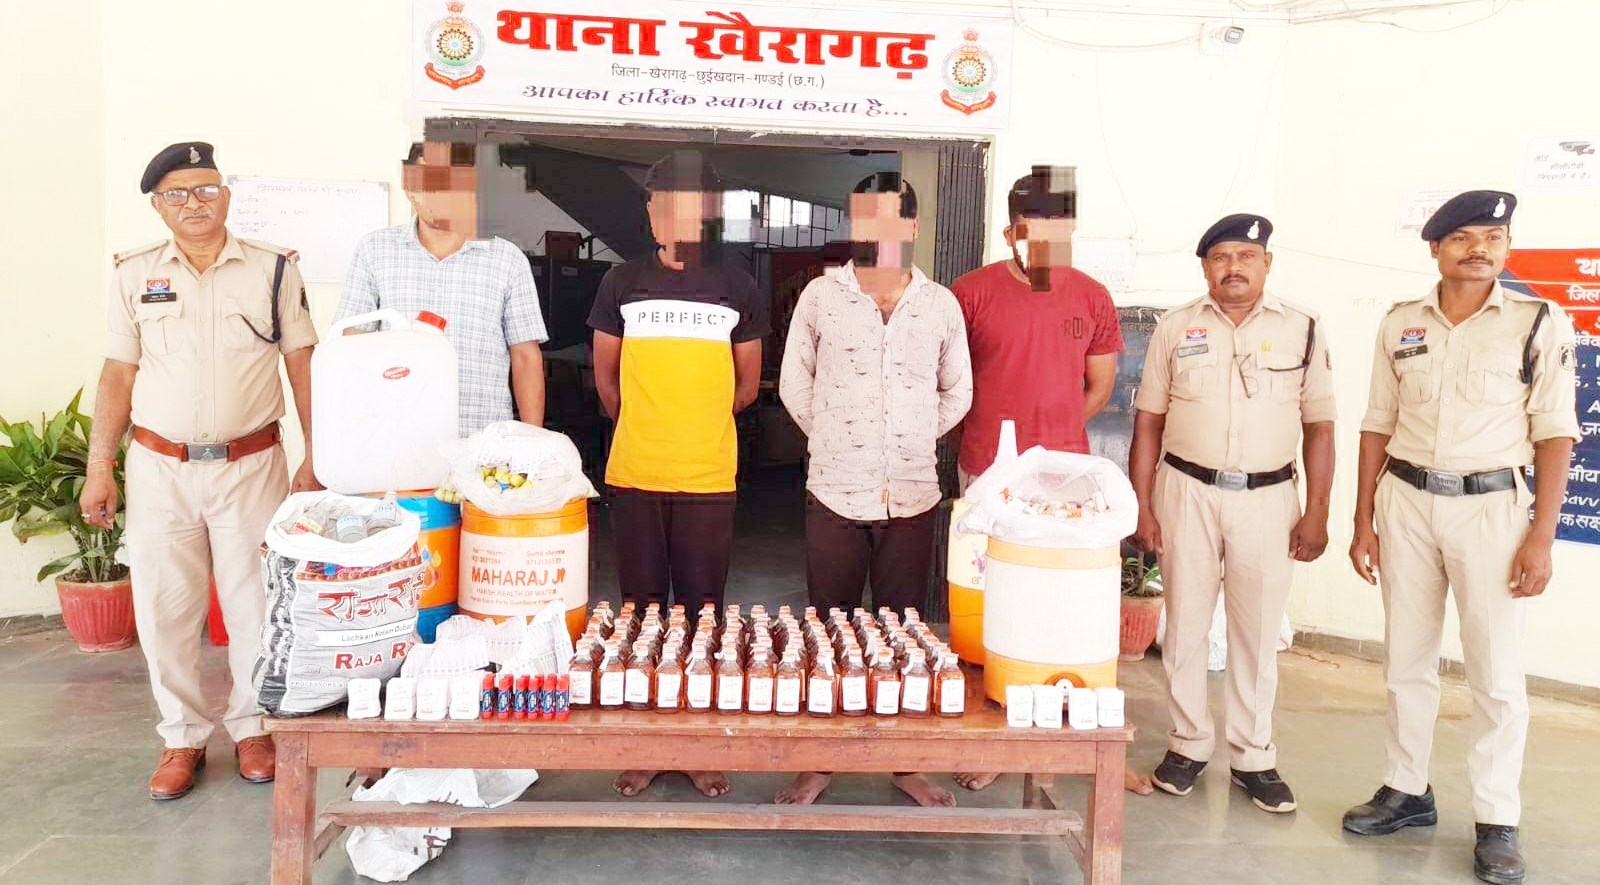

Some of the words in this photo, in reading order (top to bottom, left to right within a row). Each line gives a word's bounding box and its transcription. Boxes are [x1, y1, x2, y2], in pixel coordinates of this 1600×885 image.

[496, 9, 666, 57] थाना
[678, 11, 936, 80] खैरागढ़
[522, 84, 609, 102] आपका
[617, 87, 697, 106] हार्दिक
[704, 95, 784, 111] स्वागत
[792, 99, 858, 114] करता
[638, 311, 727, 326] PERFECT
[471, 566, 548, 587] MAHARAJ
[335, 652, 383, 670] RAJA
